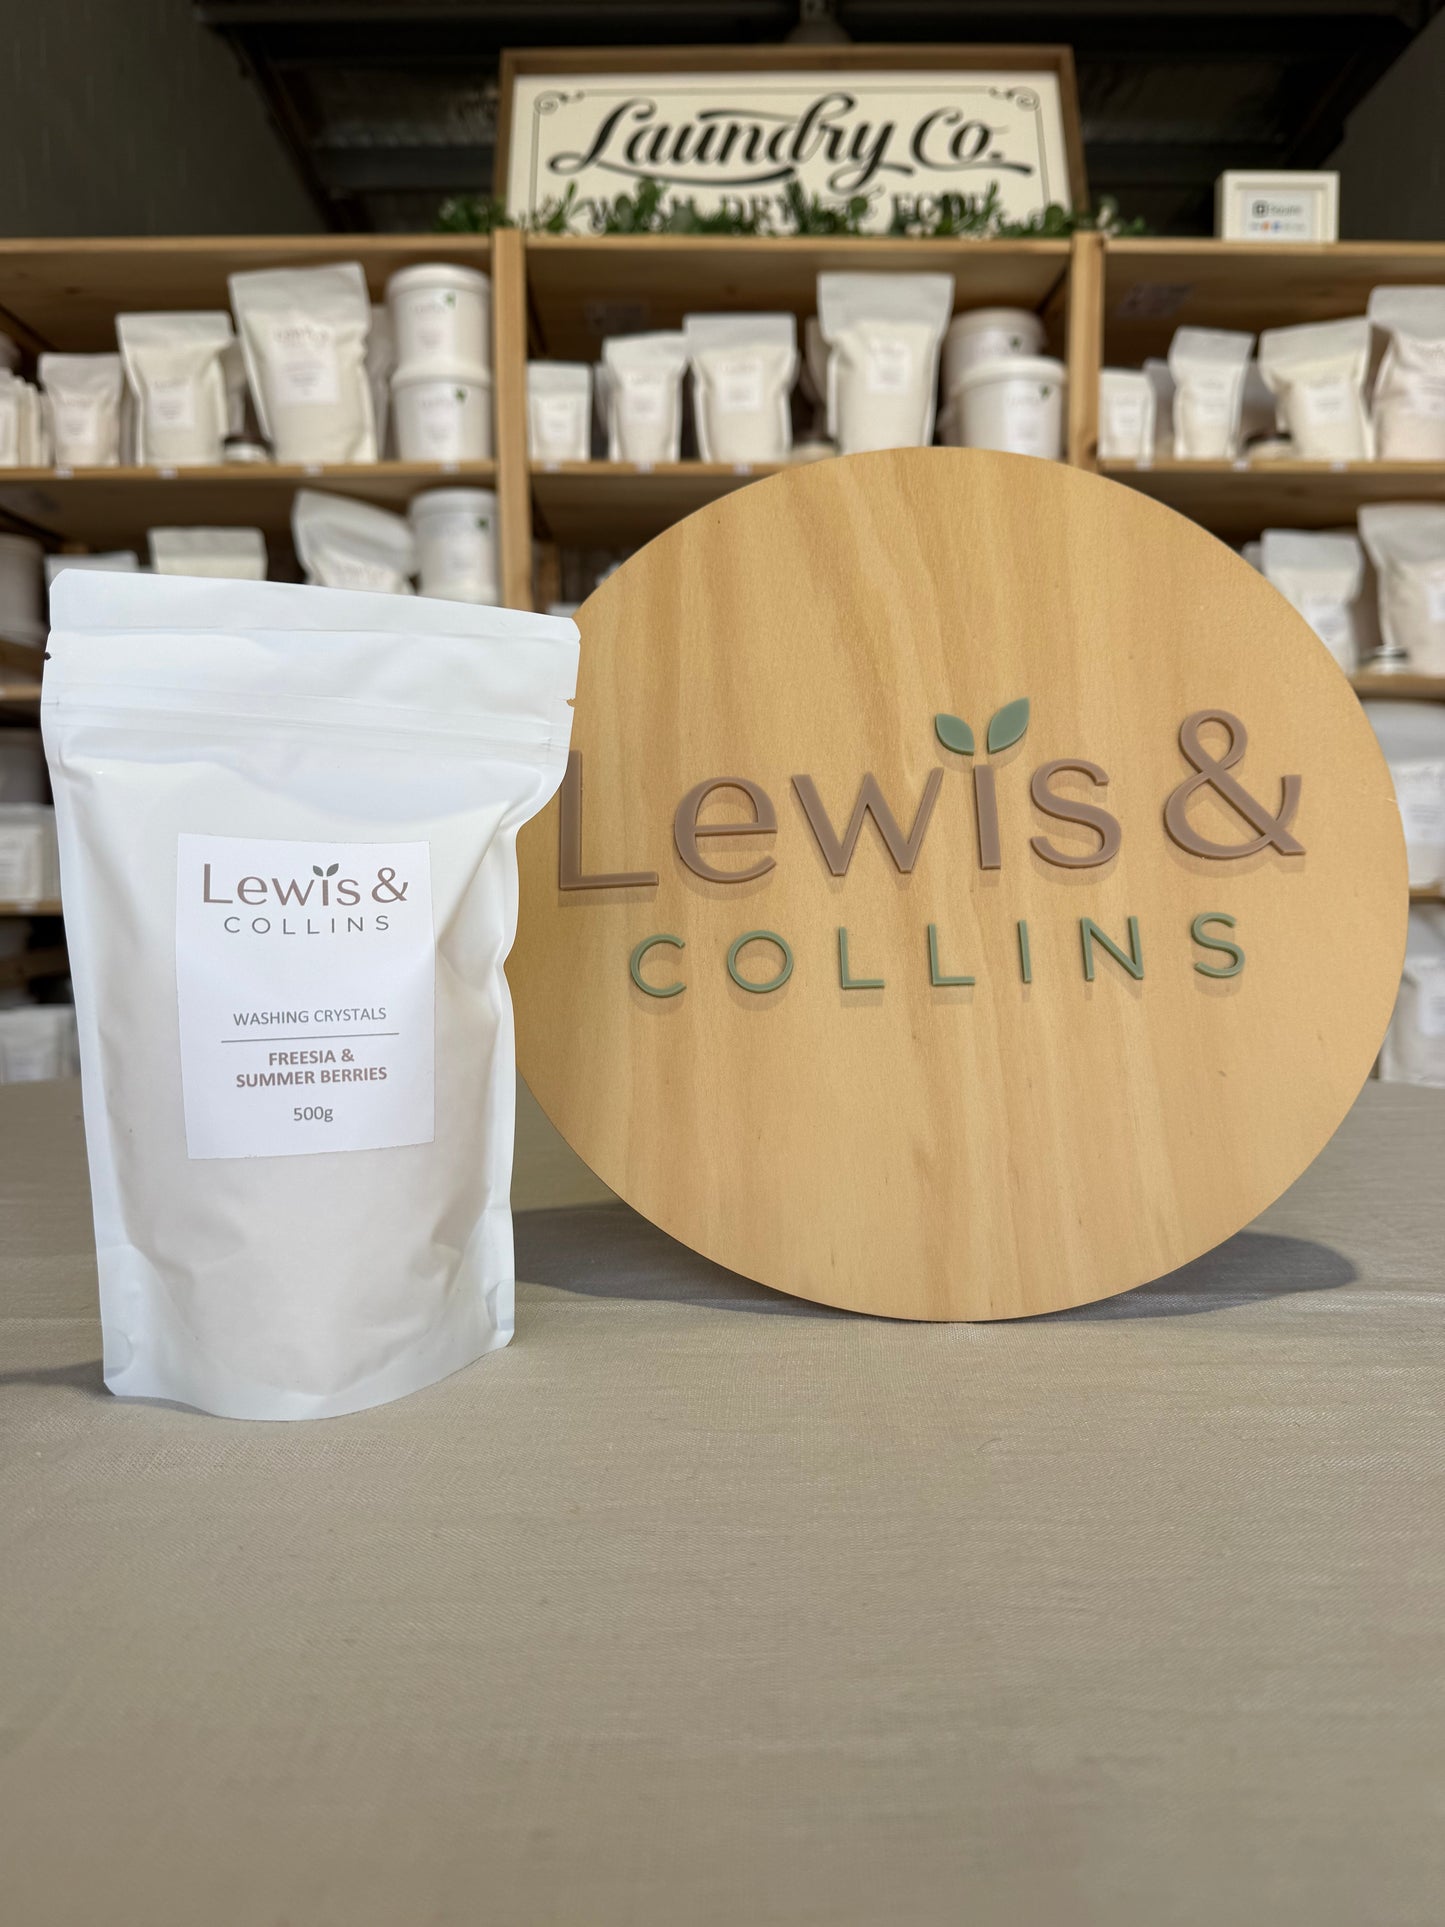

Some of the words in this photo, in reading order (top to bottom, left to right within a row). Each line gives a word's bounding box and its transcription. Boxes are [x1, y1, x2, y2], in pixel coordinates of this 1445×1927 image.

[549, 91, 914, 195] Laundry
[910, 106, 1033, 175] Co.
[559, 697, 1123, 891] Lewis
[1163, 708, 1306, 860] &
[203, 863, 361, 907] Lewis
[371, 867, 408, 904] &
[223, 914, 390, 935] COLLINS
[630, 912, 1247, 999] COLLINS
[233, 1009, 309, 1027] WASHING
[314, 1007, 387, 1023] CRYSTALS
[268, 1049, 336, 1066] FREESIA
[341, 1048, 355, 1062] &
[236, 1070, 315, 1088] SUMMER
[321, 1066, 388, 1084] BERRIES
[293, 1105, 334, 1124] 500g
